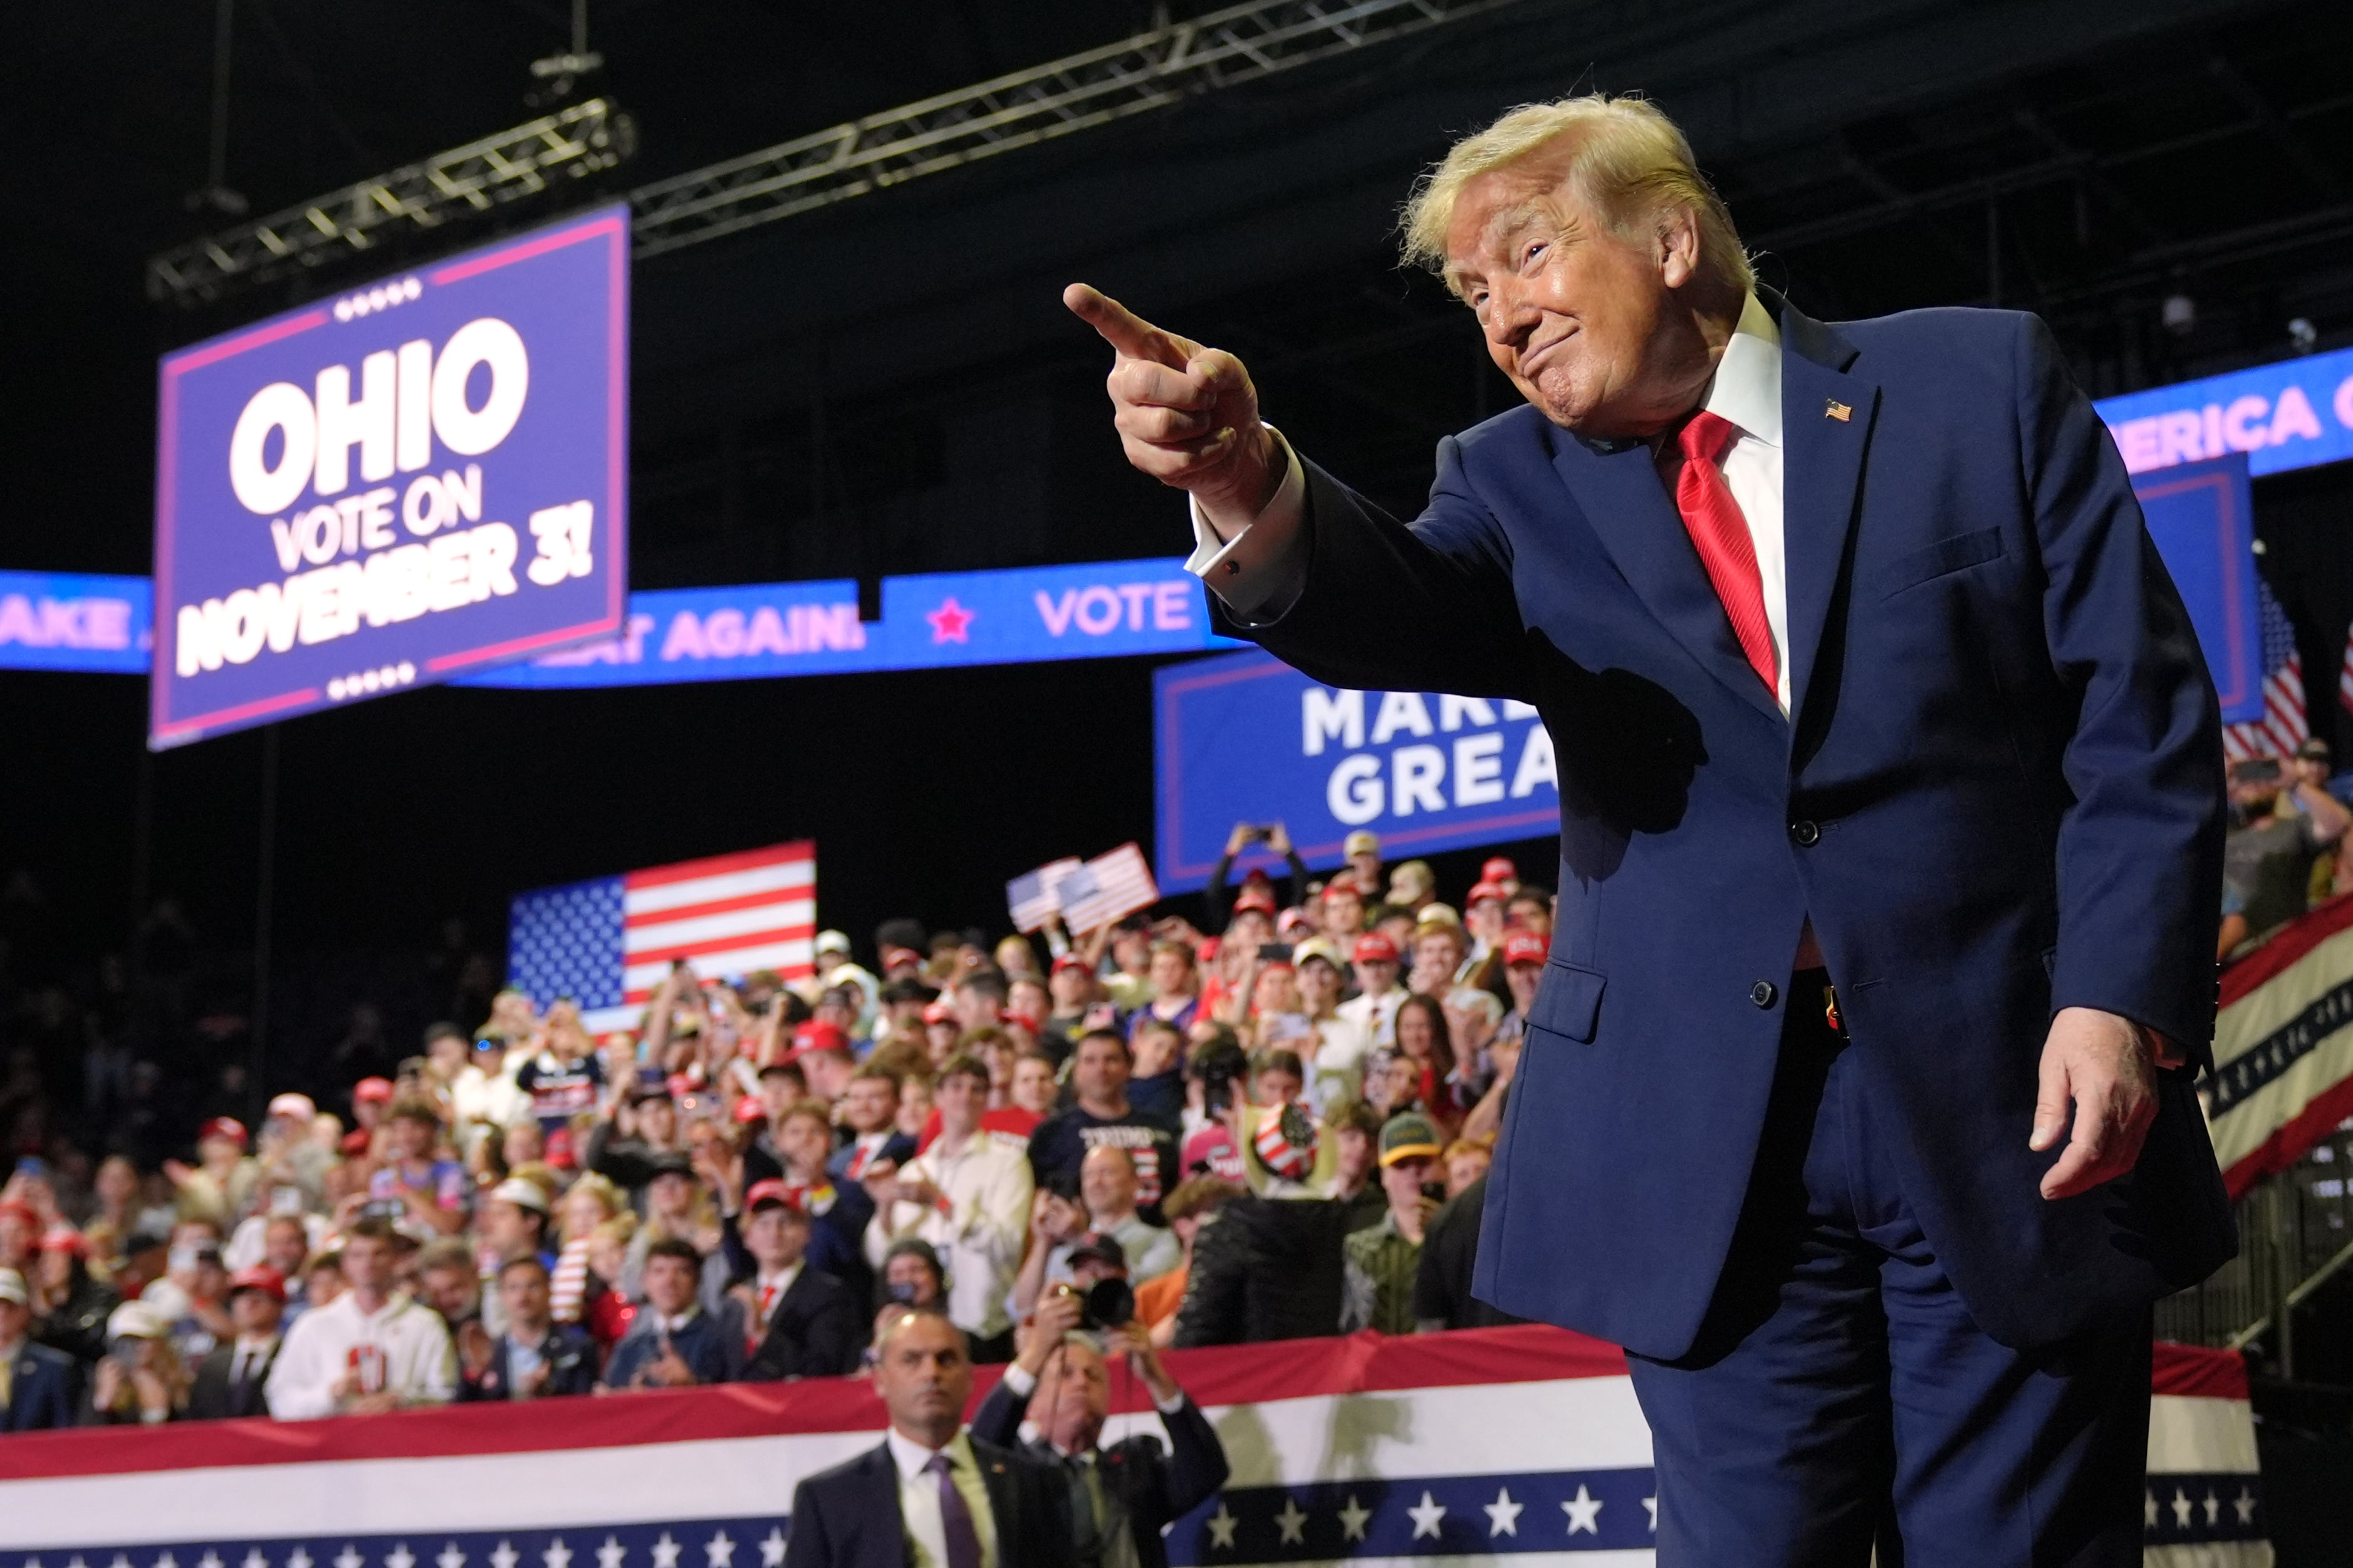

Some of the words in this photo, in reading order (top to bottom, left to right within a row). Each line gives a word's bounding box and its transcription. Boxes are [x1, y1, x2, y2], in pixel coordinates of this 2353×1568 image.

[229, 317, 530, 516] OHIO
[2109, 386, 2322, 474] ERICA
[270, 487, 397, 571] VOTE
[402, 464, 483, 537] ON
[175, 521, 519, 678] NOVEMBER
[527, 499, 594, 586] 3!
[1035, 581, 1192, 636] VOTE
[1327, 723, 1559, 826] GREA
